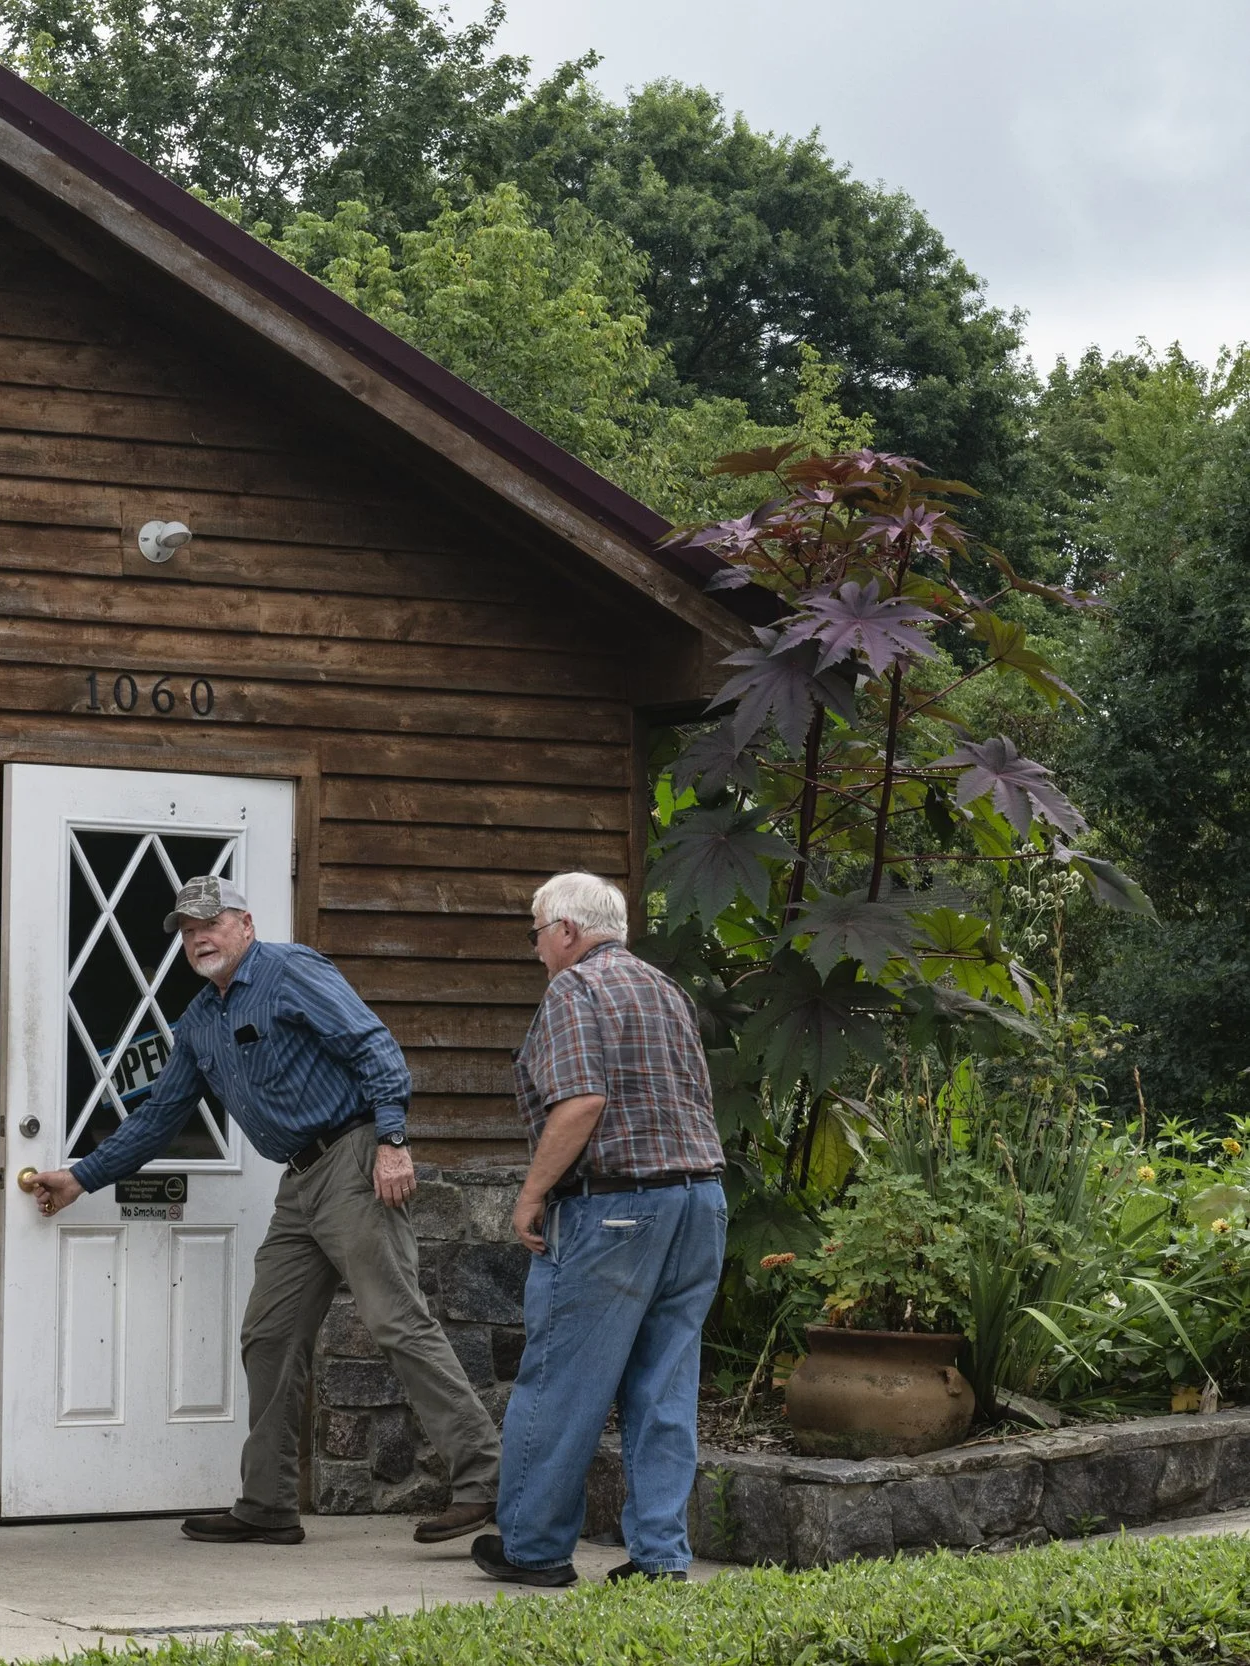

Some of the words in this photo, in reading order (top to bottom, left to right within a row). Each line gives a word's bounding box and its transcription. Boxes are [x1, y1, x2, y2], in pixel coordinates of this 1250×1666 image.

[85, 671, 215, 716] 1060
[121, 1206, 132, 1217] No
[133, 1206, 167, 1219] Smoking
